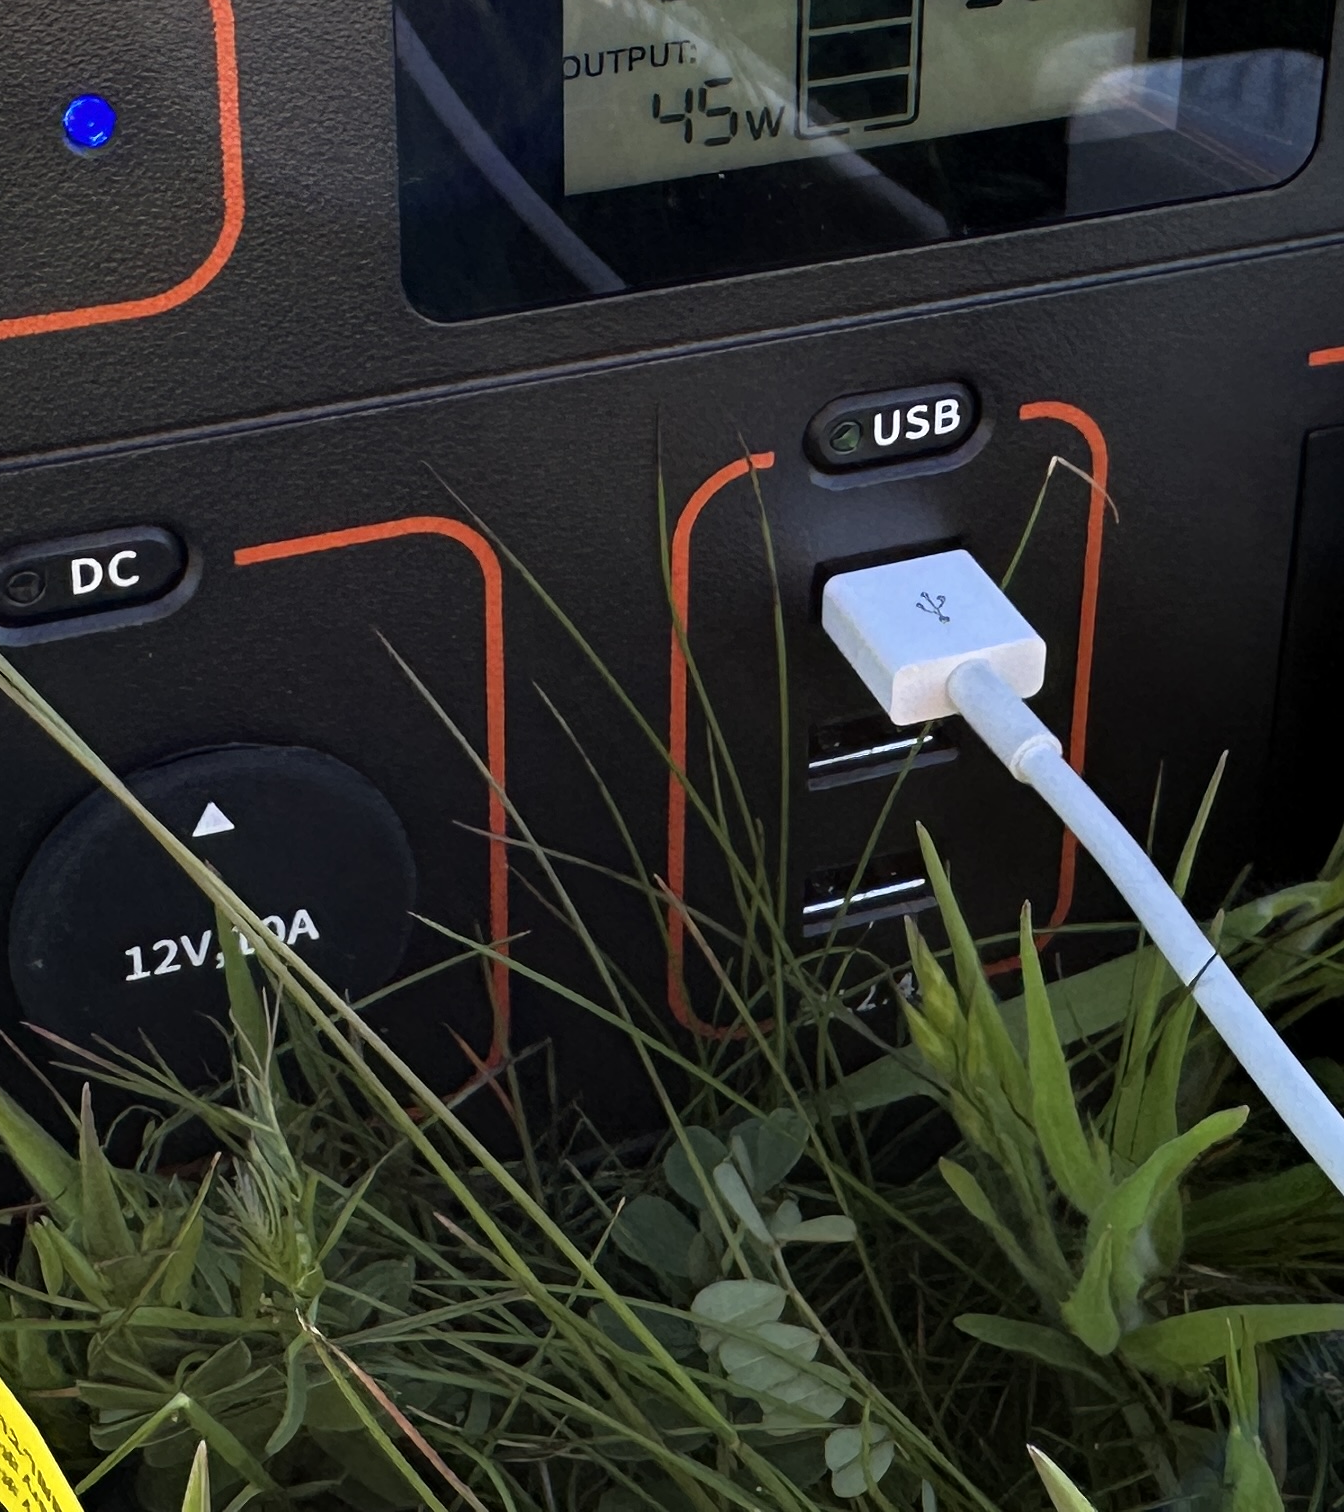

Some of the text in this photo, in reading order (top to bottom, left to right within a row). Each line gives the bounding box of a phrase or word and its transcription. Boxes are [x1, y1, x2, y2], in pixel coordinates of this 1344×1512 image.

[561, 40, 698, 80] OUTPUT:
[872, 397, 962, 447] USB
[70, 549, 141, 595] DC
